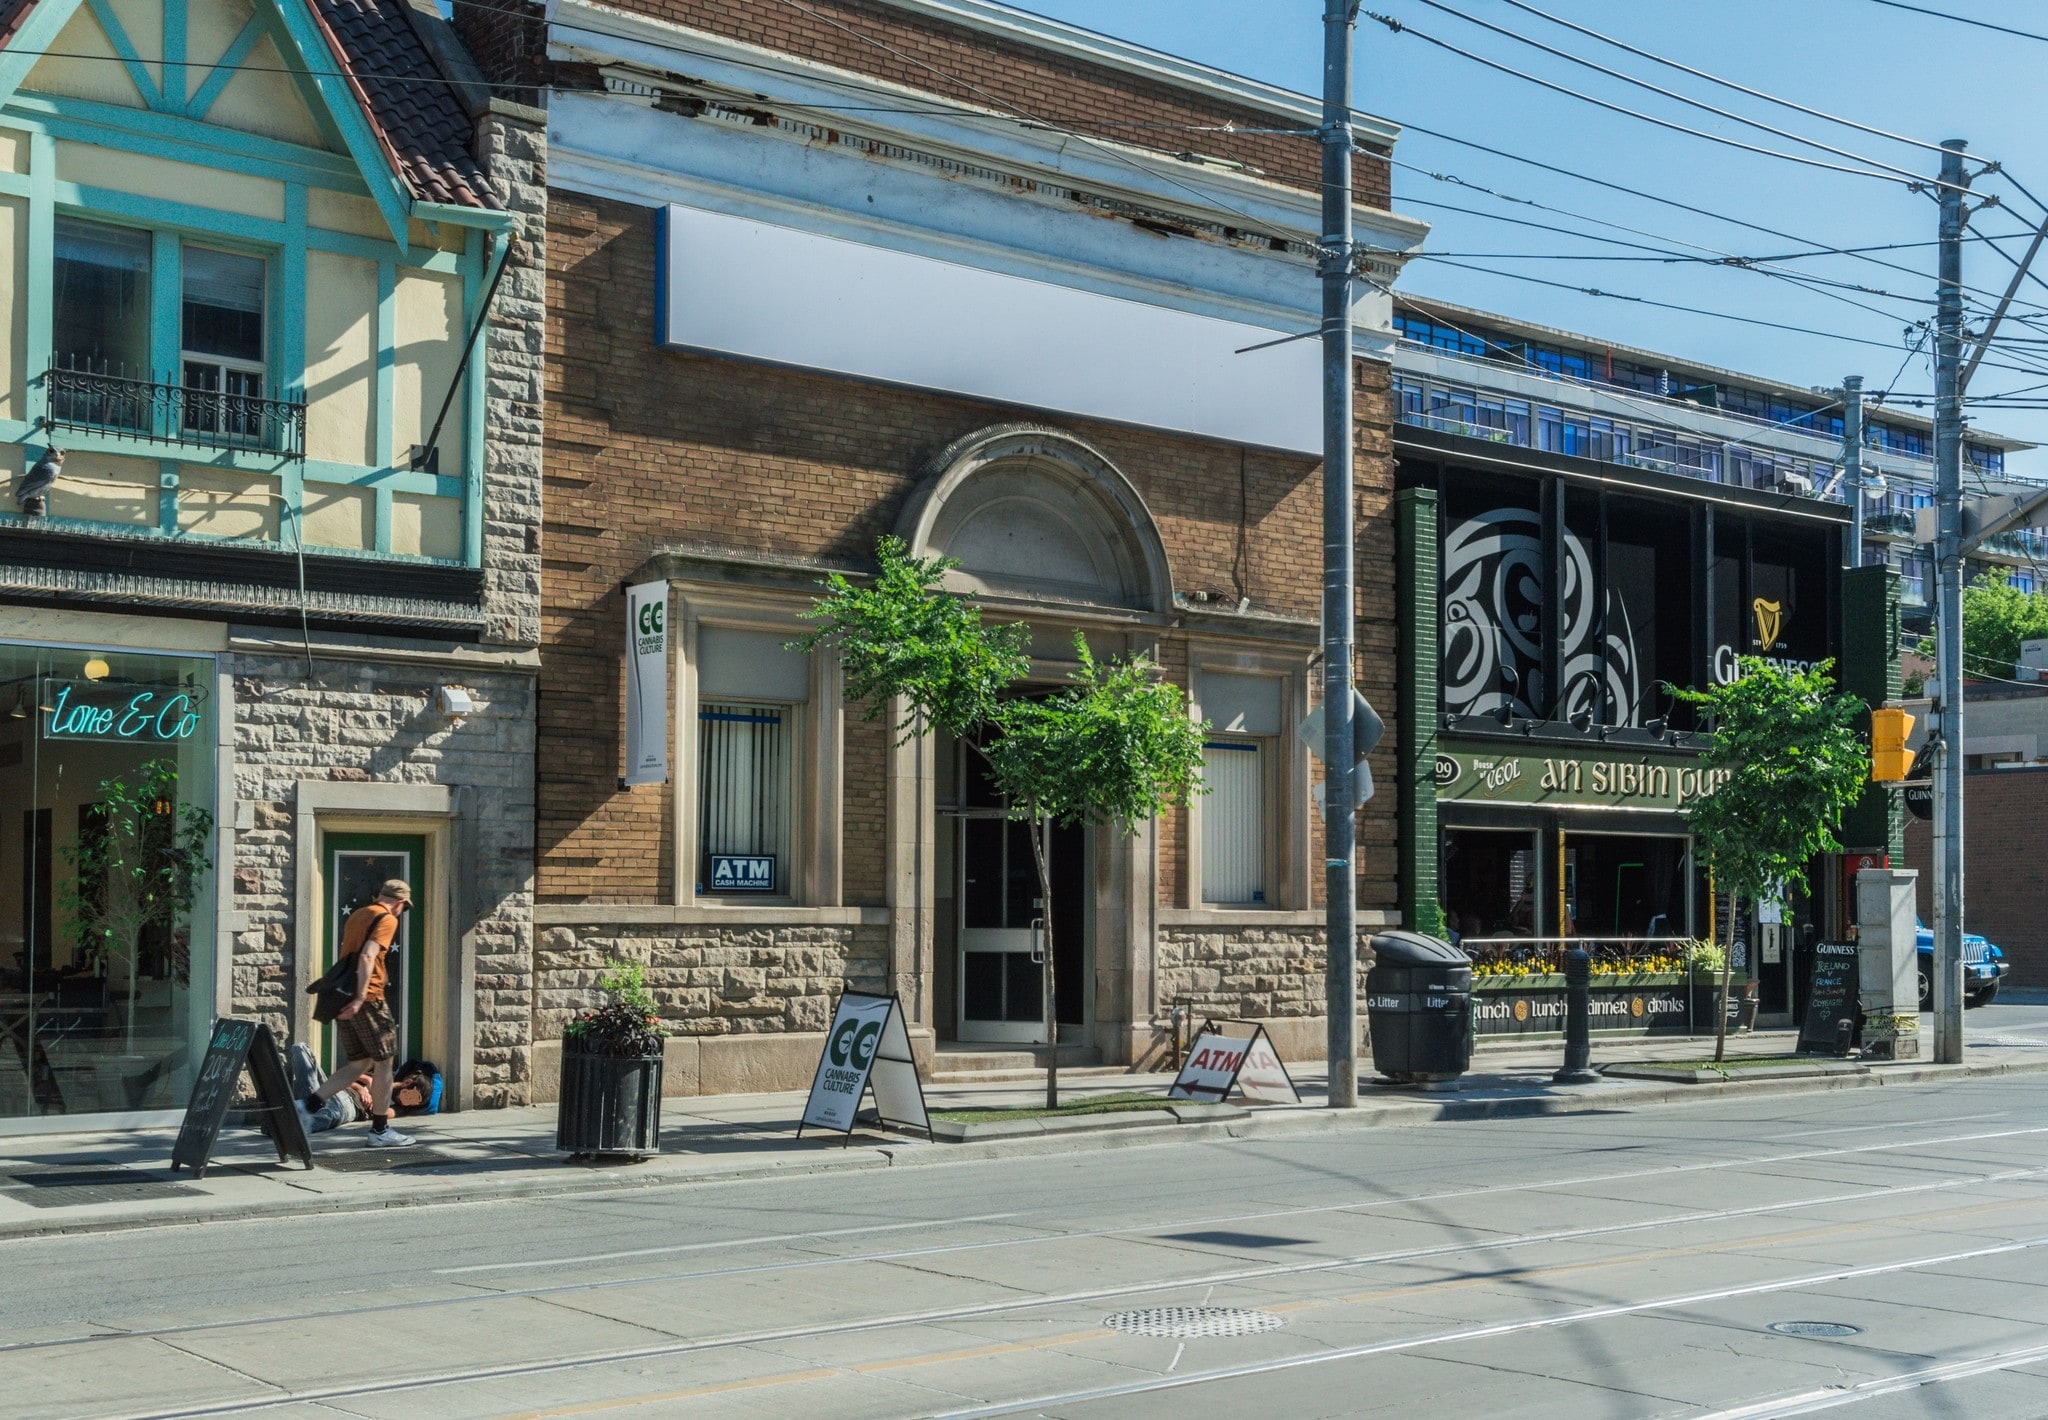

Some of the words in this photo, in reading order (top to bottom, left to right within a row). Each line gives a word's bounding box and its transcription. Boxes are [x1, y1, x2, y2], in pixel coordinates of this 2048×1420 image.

[638, 635, 664, 647] CANNABIS
[639, 644, 662, 655] CULTURE
[119, 692, 155, 737] &
[157, 694, 201, 739] Co
[715, 859, 769, 879] ATM
[715, 879, 735, 887] CASH
[737, 879, 769, 887] MACHINE
[1816, 943, 1856, 955] GUINNESS
[1377, 996, 1399, 1008] Litter
[1476, 1001, 1510, 1019] unch
[1190, 1048, 1243, 1073] ATM
[825, 1068, 861, 1084] CANNABIS
[823, 1080, 855, 1095] CULTURE
